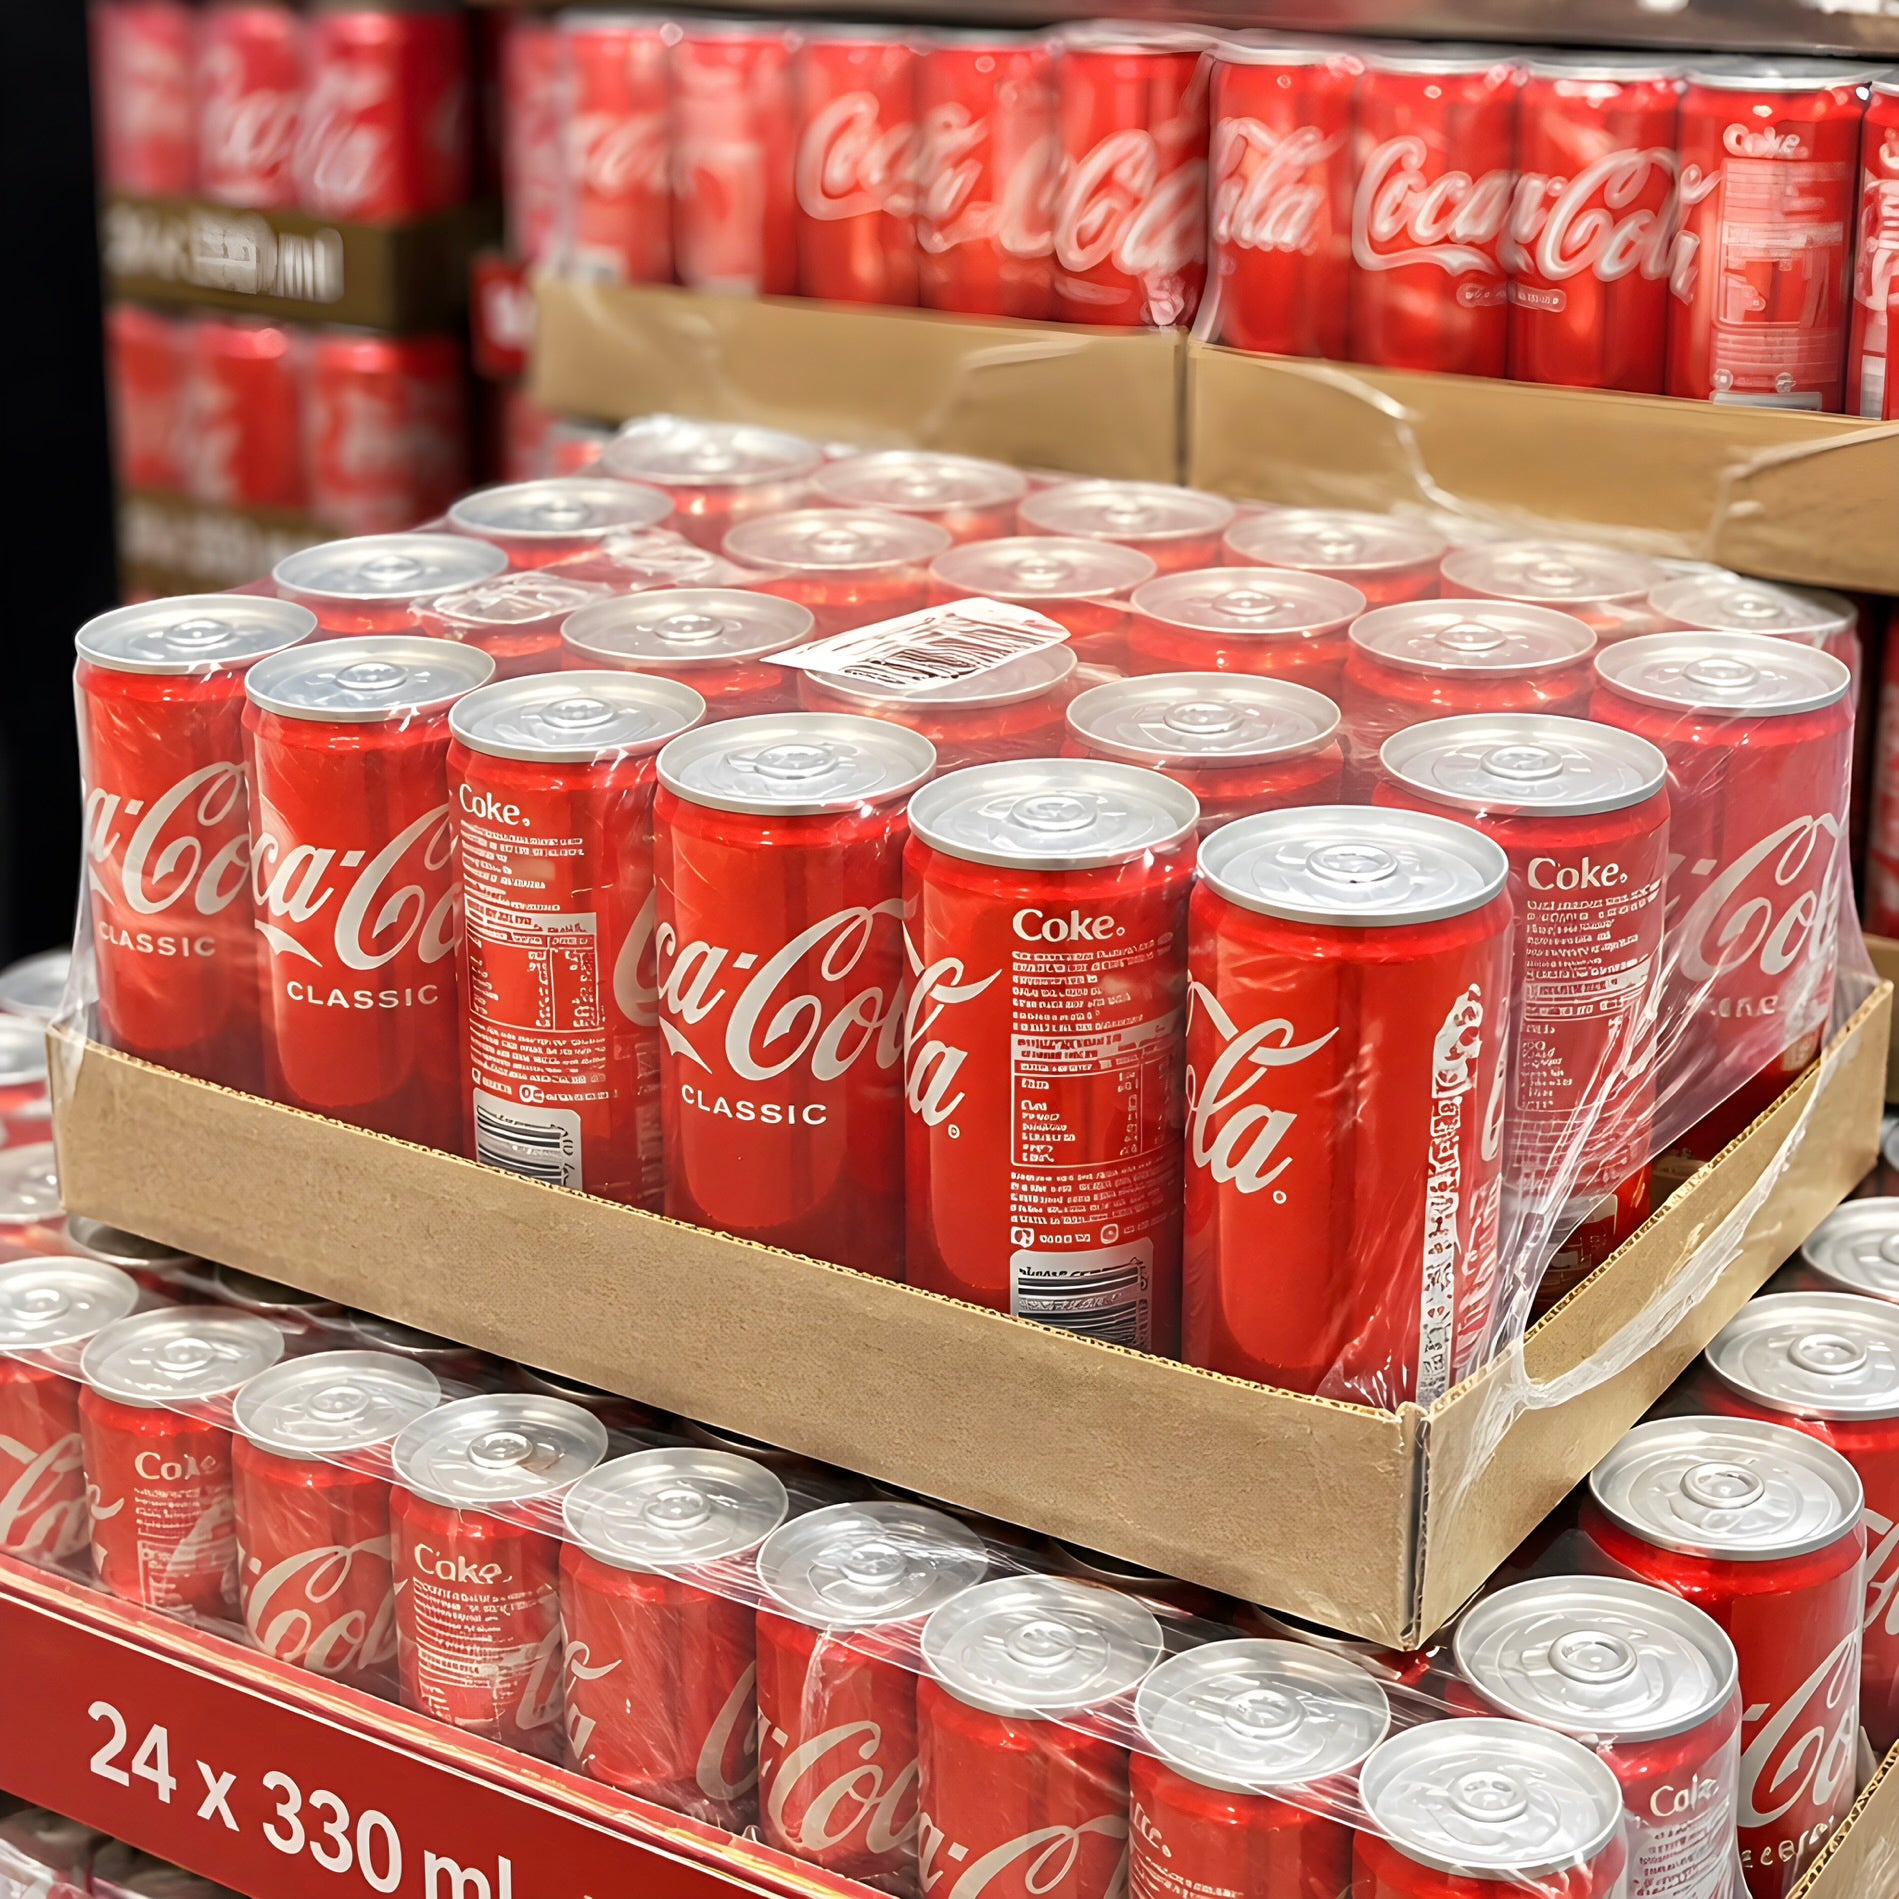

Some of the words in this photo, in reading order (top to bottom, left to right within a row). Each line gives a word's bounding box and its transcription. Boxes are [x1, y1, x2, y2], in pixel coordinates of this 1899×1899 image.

[99, 921, 216, 957] CLASSIC
[287, 981, 438, 1009] CLASSIC
[682, 1084, 827, 1126] CLASSIC
[88, 1701, 176, 1804] 24
[196, 1759, 240, 1832] x
[262, 1770, 402, 1893] 330
[424, 1849, 511, 1899] ml
